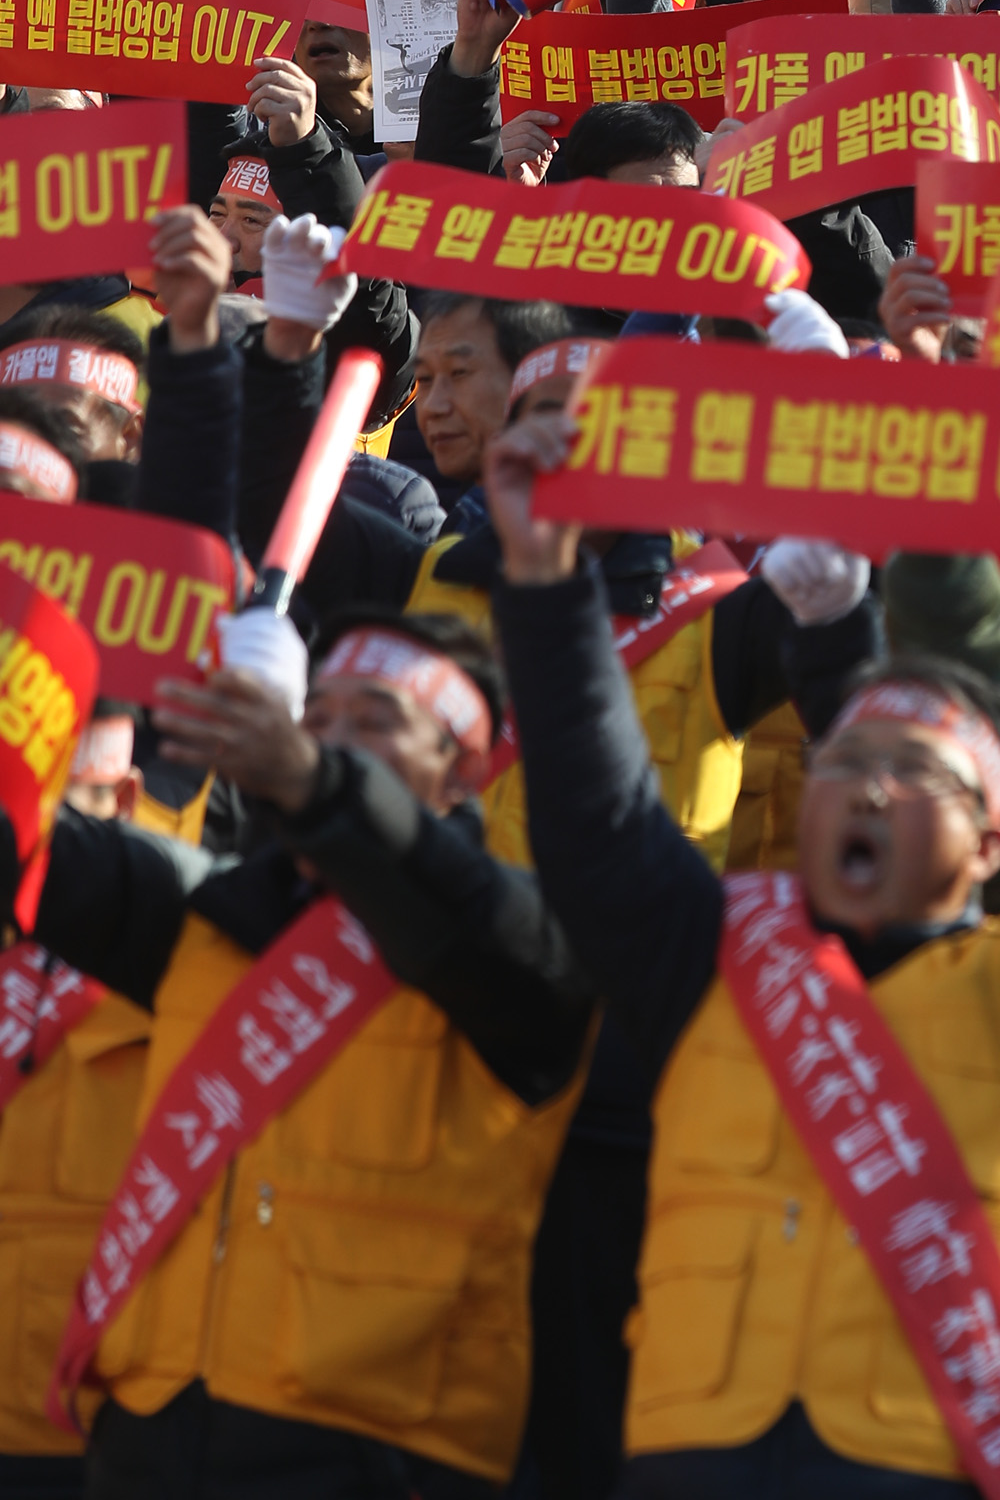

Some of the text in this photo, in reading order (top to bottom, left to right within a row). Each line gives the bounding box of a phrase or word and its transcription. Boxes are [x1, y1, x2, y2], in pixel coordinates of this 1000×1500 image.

[191, 3, 292, 67] OUT!
[541, 42, 726, 103] 앱 불법영업
[735, 53, 808, 113] 카풀
[717, 90, 982, 199] 카풀 앱 불법영업
[36, 144, 173, 235] OUT!
[434, 204, 492, 261] 앱
[495, 209, 674, 272] 불법영업
[674, 221, 800, 292] OUT!
[3, 344, 59, 383] 카풀앱
[573, 386, 677, 480] 카풀
[691, 389, 754, 486] 앱
[764, 397, 988, 504] 불법영업
